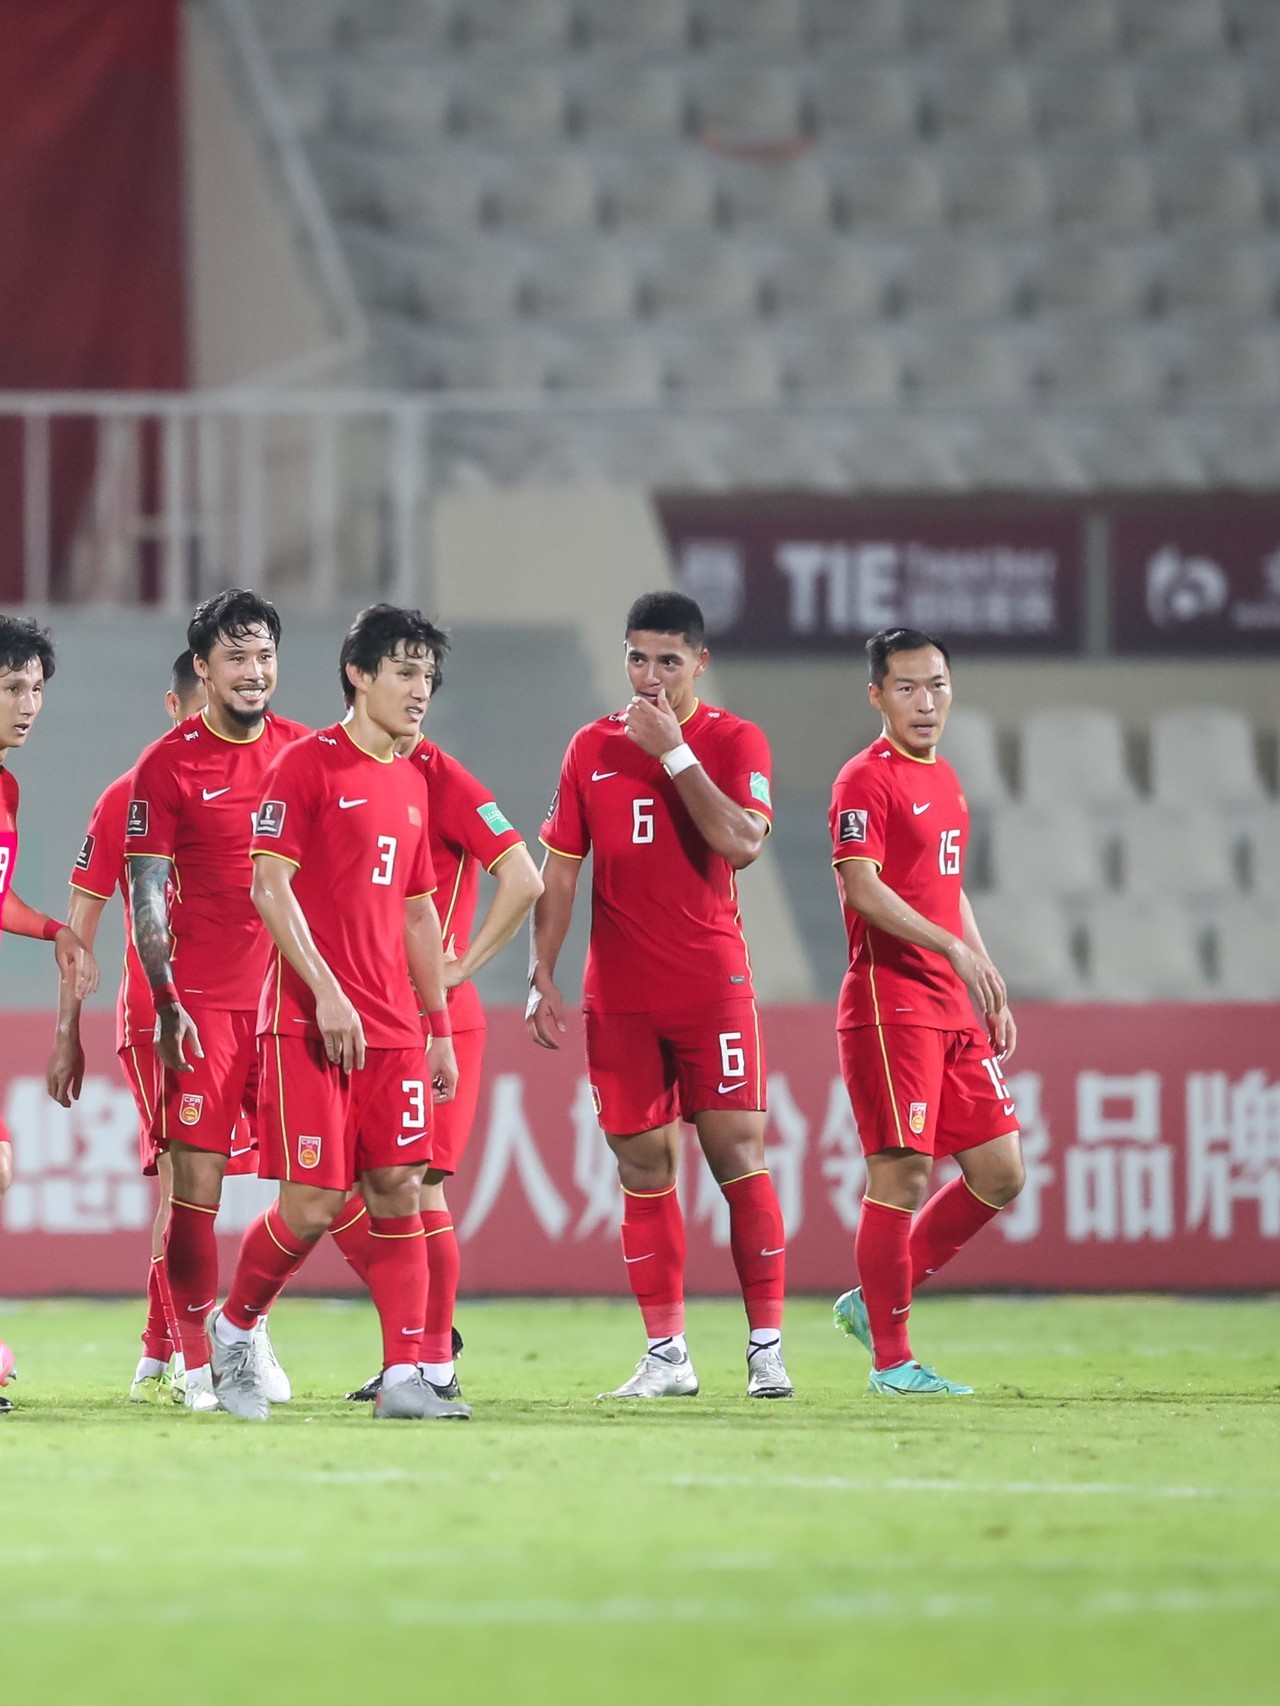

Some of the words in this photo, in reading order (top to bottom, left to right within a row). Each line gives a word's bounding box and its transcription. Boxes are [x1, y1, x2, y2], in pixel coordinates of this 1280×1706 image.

[775, 540, 899, 634] TIE
[632, 798, 654, 843] 6
[372, 835, 398, 885] 3
[939, 829, 961, 875] 15
[718, 1032, 745, 1077] 6
[402, 1080, 425, 1128] 3
